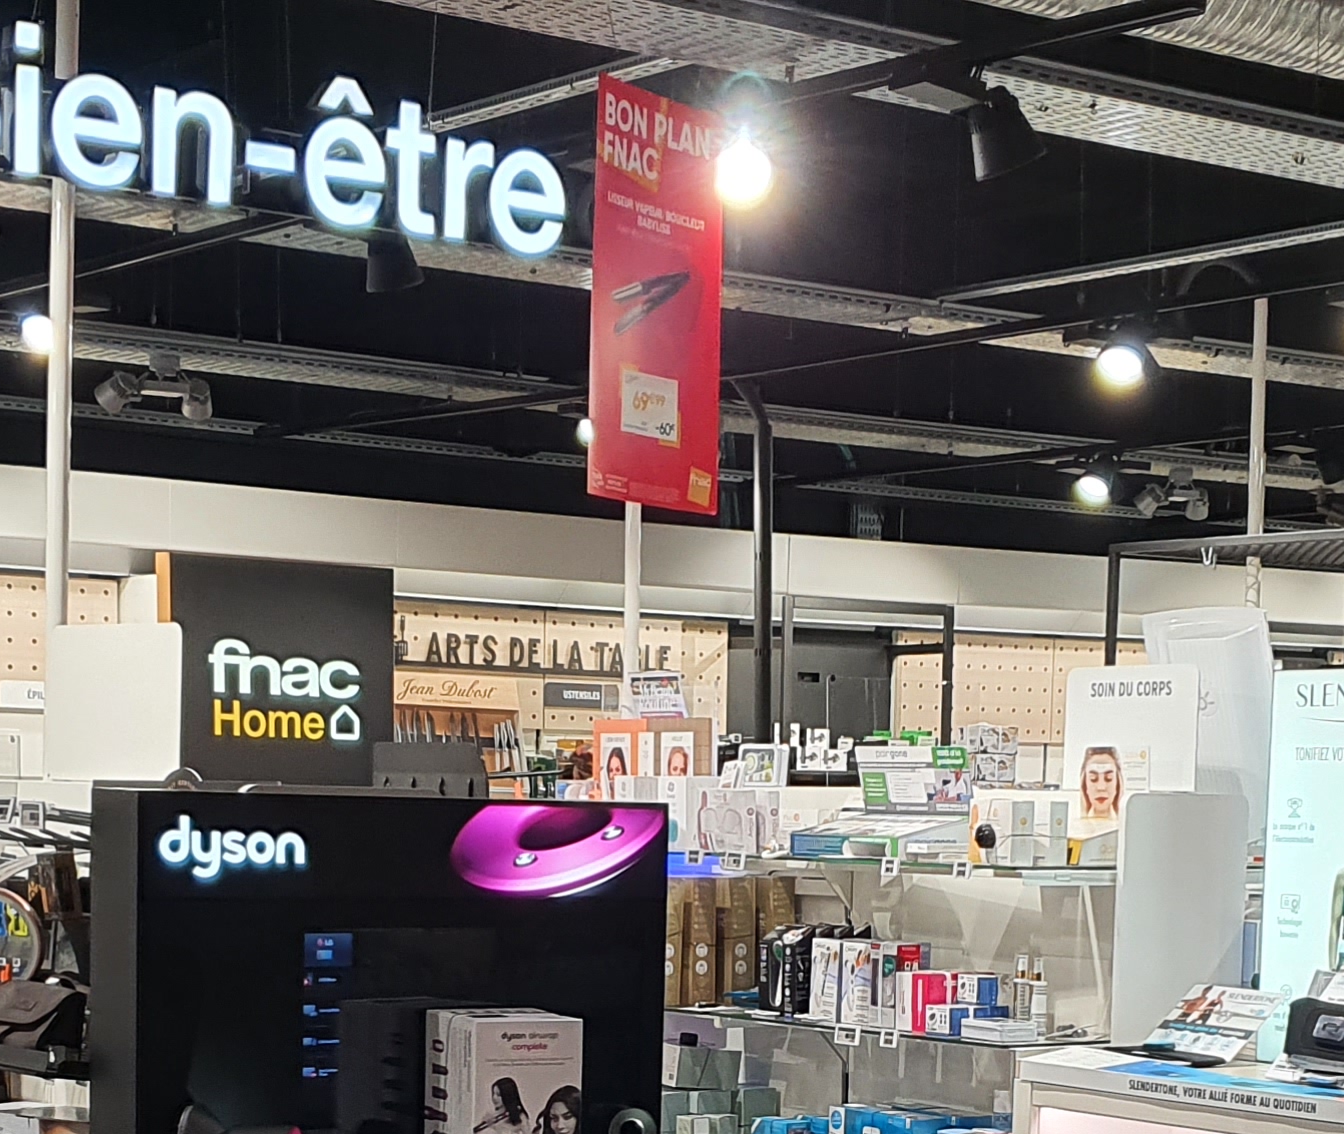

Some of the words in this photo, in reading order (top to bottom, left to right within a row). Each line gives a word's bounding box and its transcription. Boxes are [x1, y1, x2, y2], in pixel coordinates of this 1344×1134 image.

[605, 92, 648, 139] BON
[654, 111, 712, 160] PLAN
[603, 130, 660, 181] FNAC
[208, 637, 361, 700] fnac
[425, 631, 497, 666] ARTS
[509, 635, 541, 669] DE
[552, 638, 584, 671] LA
[595, 641, 672, 672] TALE
[396, 678, 434, 700] Jean
[441, 679, 497, 700] Dubost
[1090, 682, 1116, 698] SOIN
[1119, 681, 1134, 697] DU
[1136, 680, 1173, 697] CORPS
[213, 699, 326, 741] Home
[1295, 746, 1330, 762] TONIFIEZ
[158, 814, 306, 879] dyson
[1182, 1086, 1207, 1100] VOTRE
[1230, 1092, 1258, 1107] FORME
[1258, 1096, 1271, 1108] AU
[1272, 1098, 1318, 1114] QUOTIDIEN
